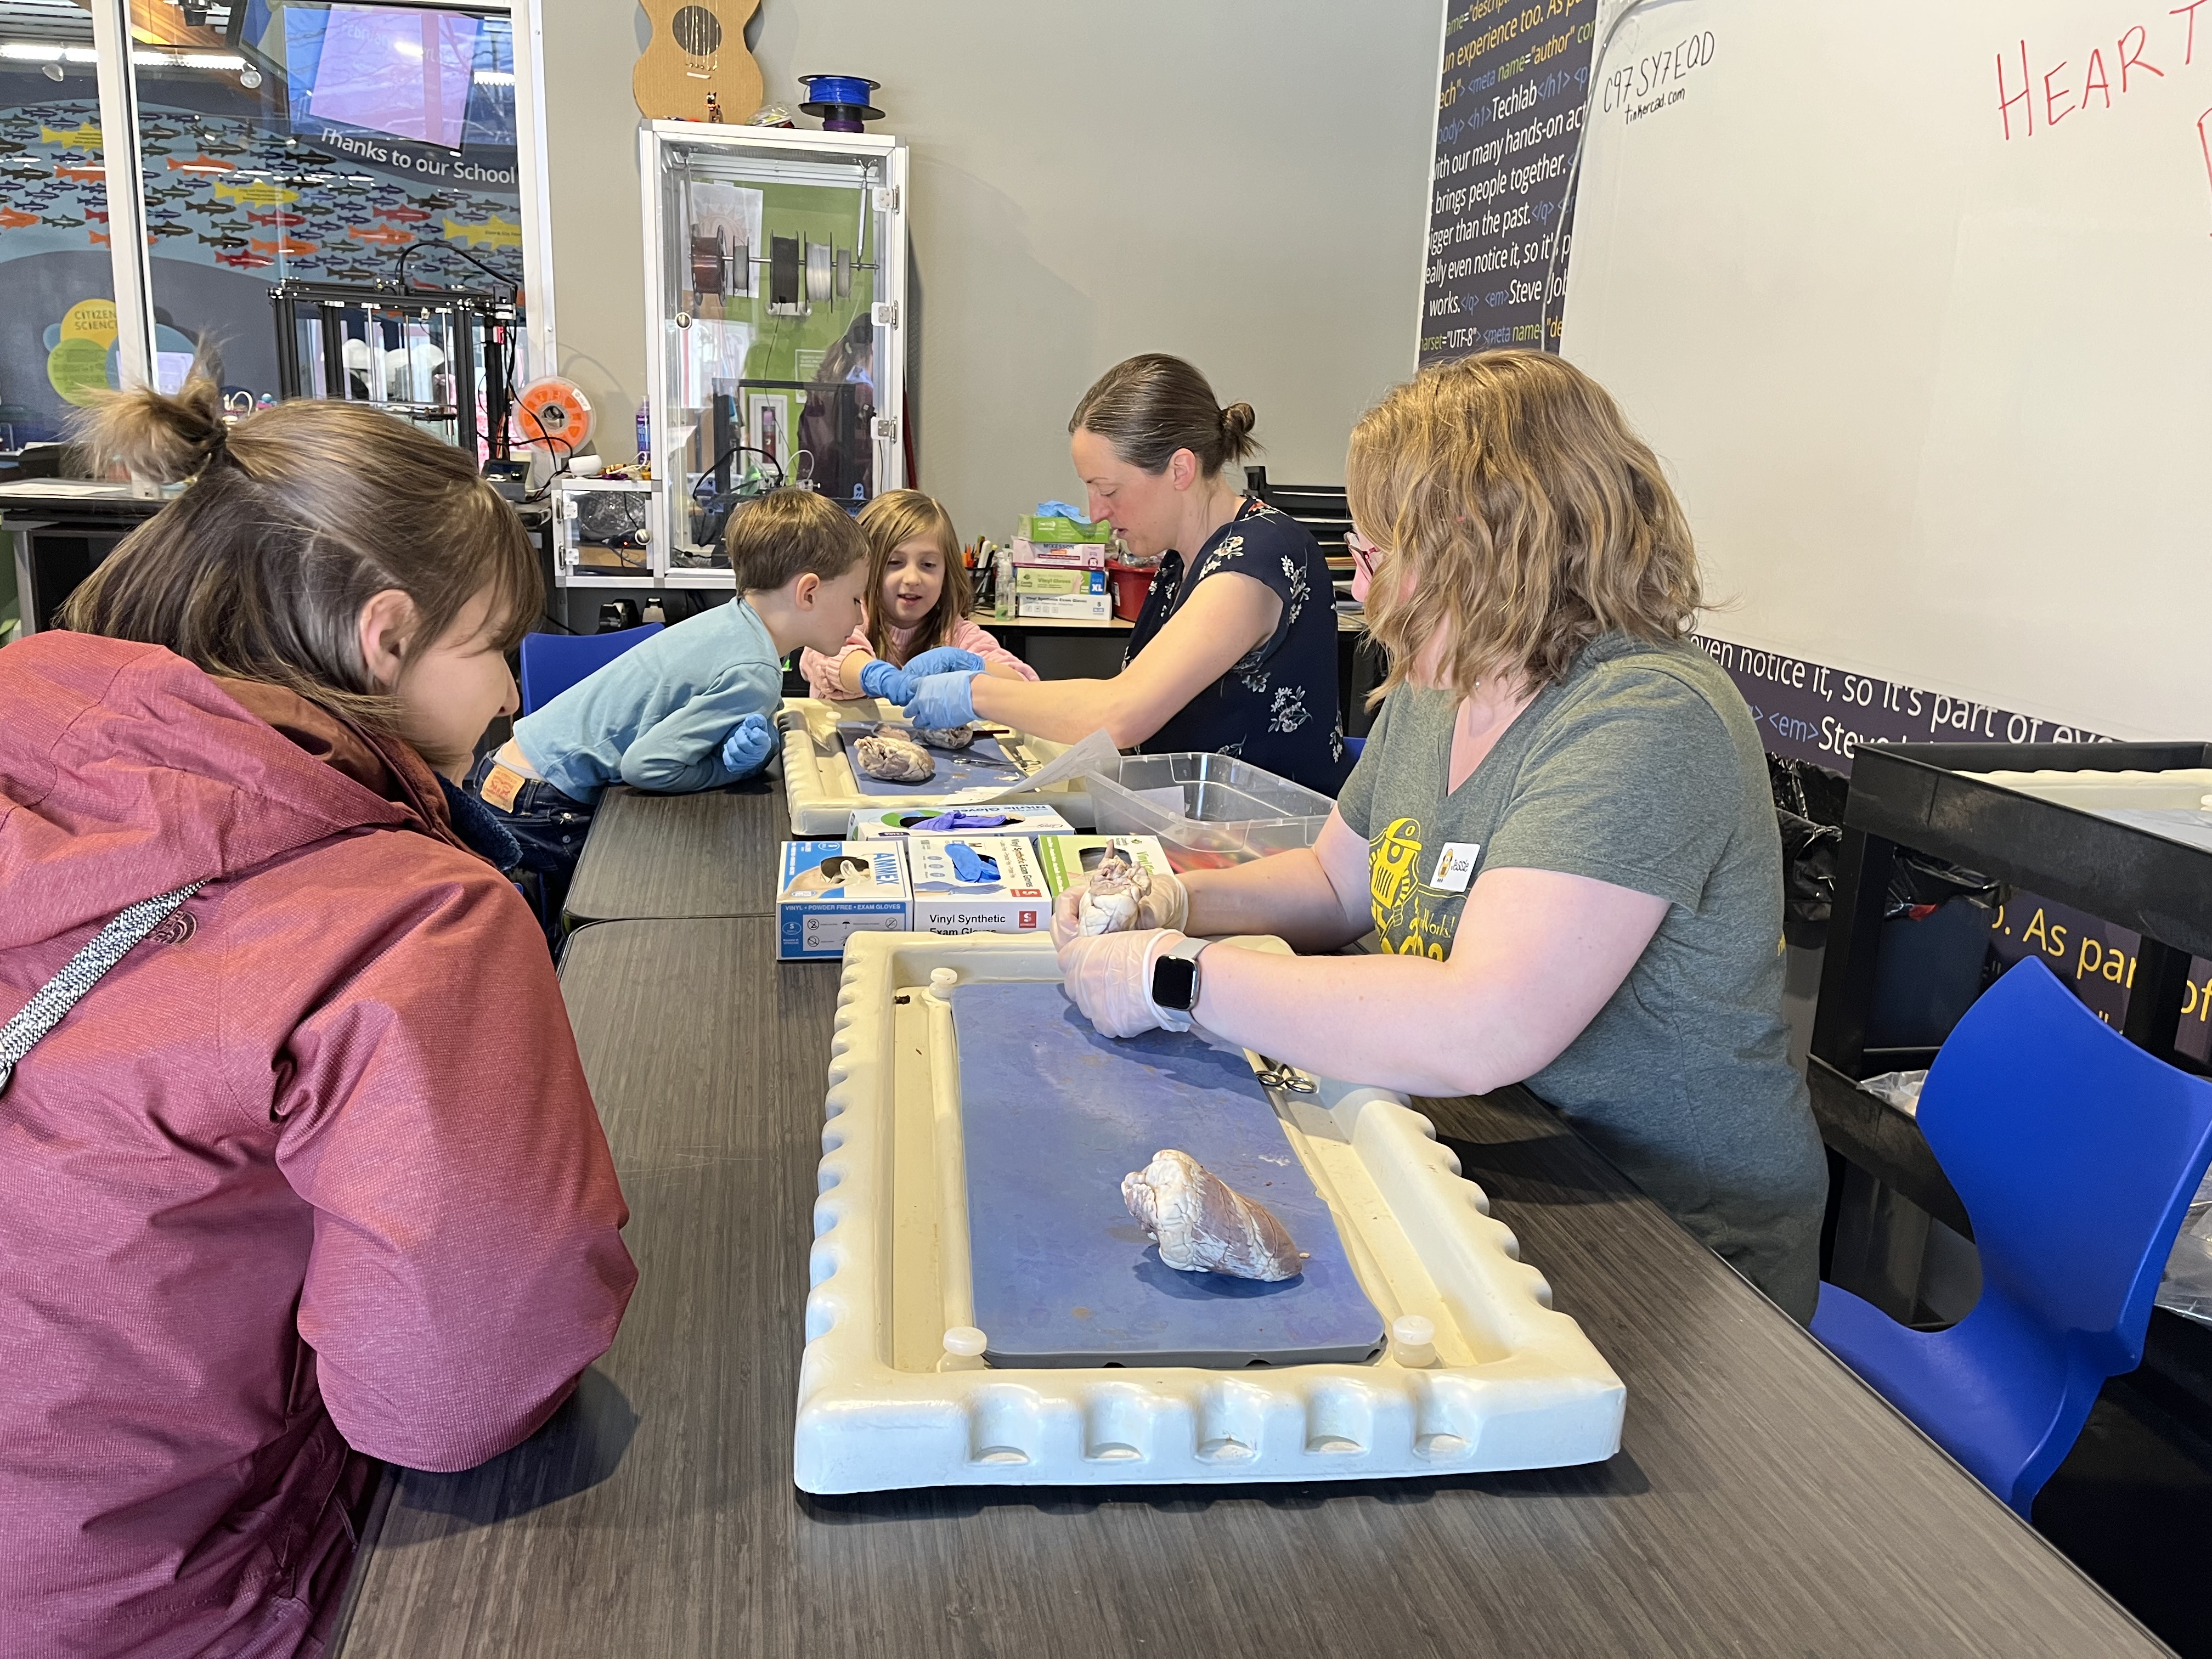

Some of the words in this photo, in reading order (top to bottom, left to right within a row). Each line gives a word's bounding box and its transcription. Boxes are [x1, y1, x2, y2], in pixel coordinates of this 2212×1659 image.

[1457, 17, 1517, 67] experience
[1520, 5, 1543, 32] too.
[1997, 0, 2207, 140] HEART
[321, 127, 387, 162] Thanks
[392, 150, 411, 168] to
[416, 158, 450, 176] our
[453, 162, 515, 184] School
[1452, 150, 1471, 174] our
[1472, 138, 1504, 165] many
[1505, 117, 1564, 155] hands-on
[1436, 188, 1466, 215] brings
[1469, 170, 1507, 211] people
[1510, 153, 1566, 194] together.
[1455, 217, 1480, 243] than
[1482, 210, 1499, 236] the
[1448, 252, 1472, 279] even
[1474, 246, 1508, 274] notice
[1510, 241, 1520, 269] it,
[1523, 241, 1538, 263] so
[75, 320, 117, 330] SCIENC
[1739, 647, 1805, 689] notice
[1842, 674, 1873, 707] so
[1930, 693, 1998, 733] part
[873, 853, 900, 885] AMMEX
[929, 914, 955, 925] Vinyl
[958, 914, 1006, 925] Synthetic
[1024, 913, 1032, 922] S
[2023, 908, 2067, 956] As
